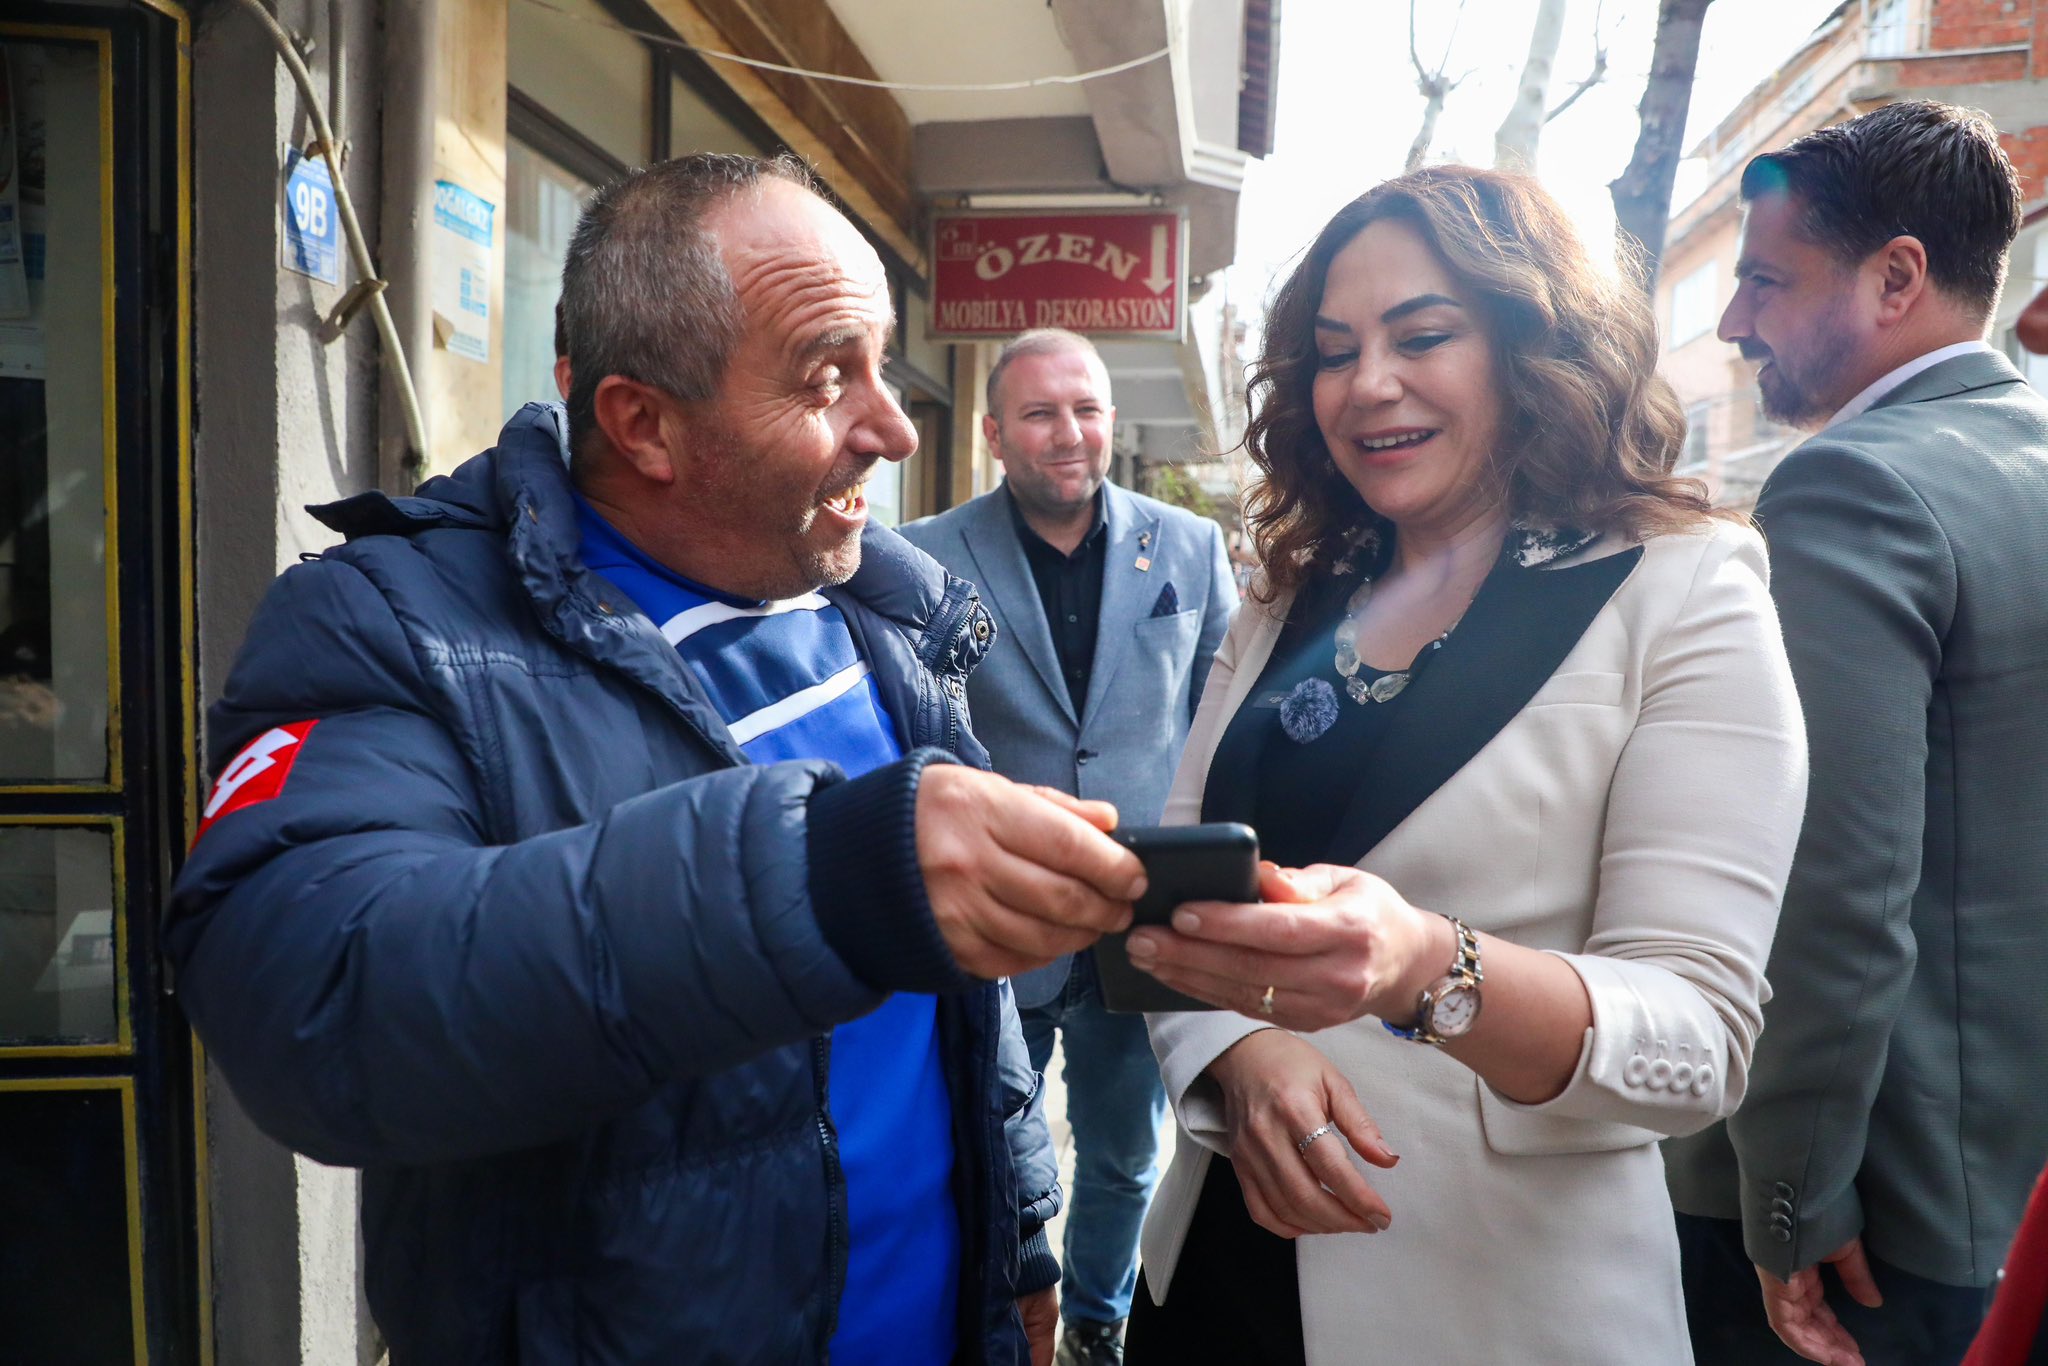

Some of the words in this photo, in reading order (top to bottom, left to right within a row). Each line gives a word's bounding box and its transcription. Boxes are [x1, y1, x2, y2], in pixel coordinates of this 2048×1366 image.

[296, 182, 327, 238] 9B
[975, 233, 1141, 281] ÖZEN
[940, 296, 1026, 328] MOBİLYA
[1036, 297, 1172, 328] DEKORASYON
